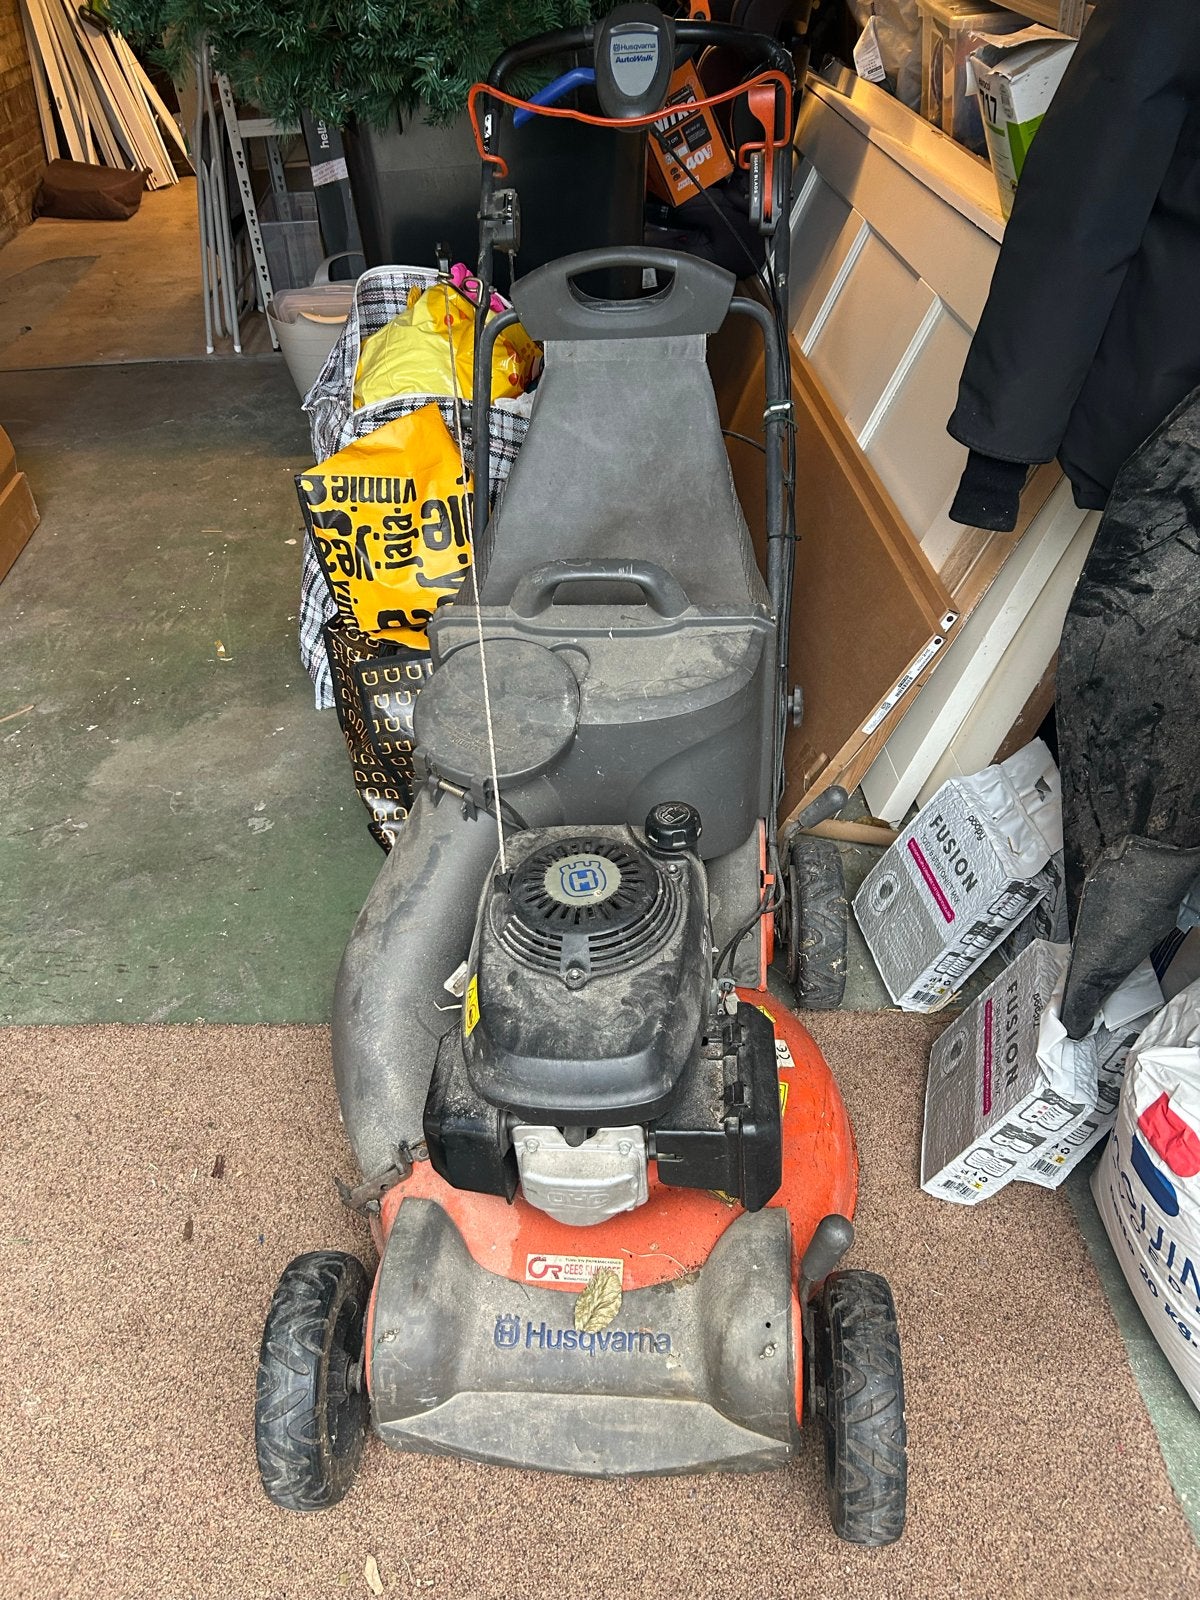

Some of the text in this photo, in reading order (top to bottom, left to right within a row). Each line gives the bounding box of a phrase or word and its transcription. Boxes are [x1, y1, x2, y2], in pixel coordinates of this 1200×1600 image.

[615, 54, 654, 64] AutoWalk
[620, 43, 656, 51] Husqvarna
[331, 476, 417, 514] vinnie
[929, 814, 978, 893] FUSION
[1006, 980, 1019, 1087] FUSION
[563, 1264, 583, 1275] CEES
[1139, 1263, 1158, 1298] 20
[525, 1321, 672, 1357] Husqvarna
